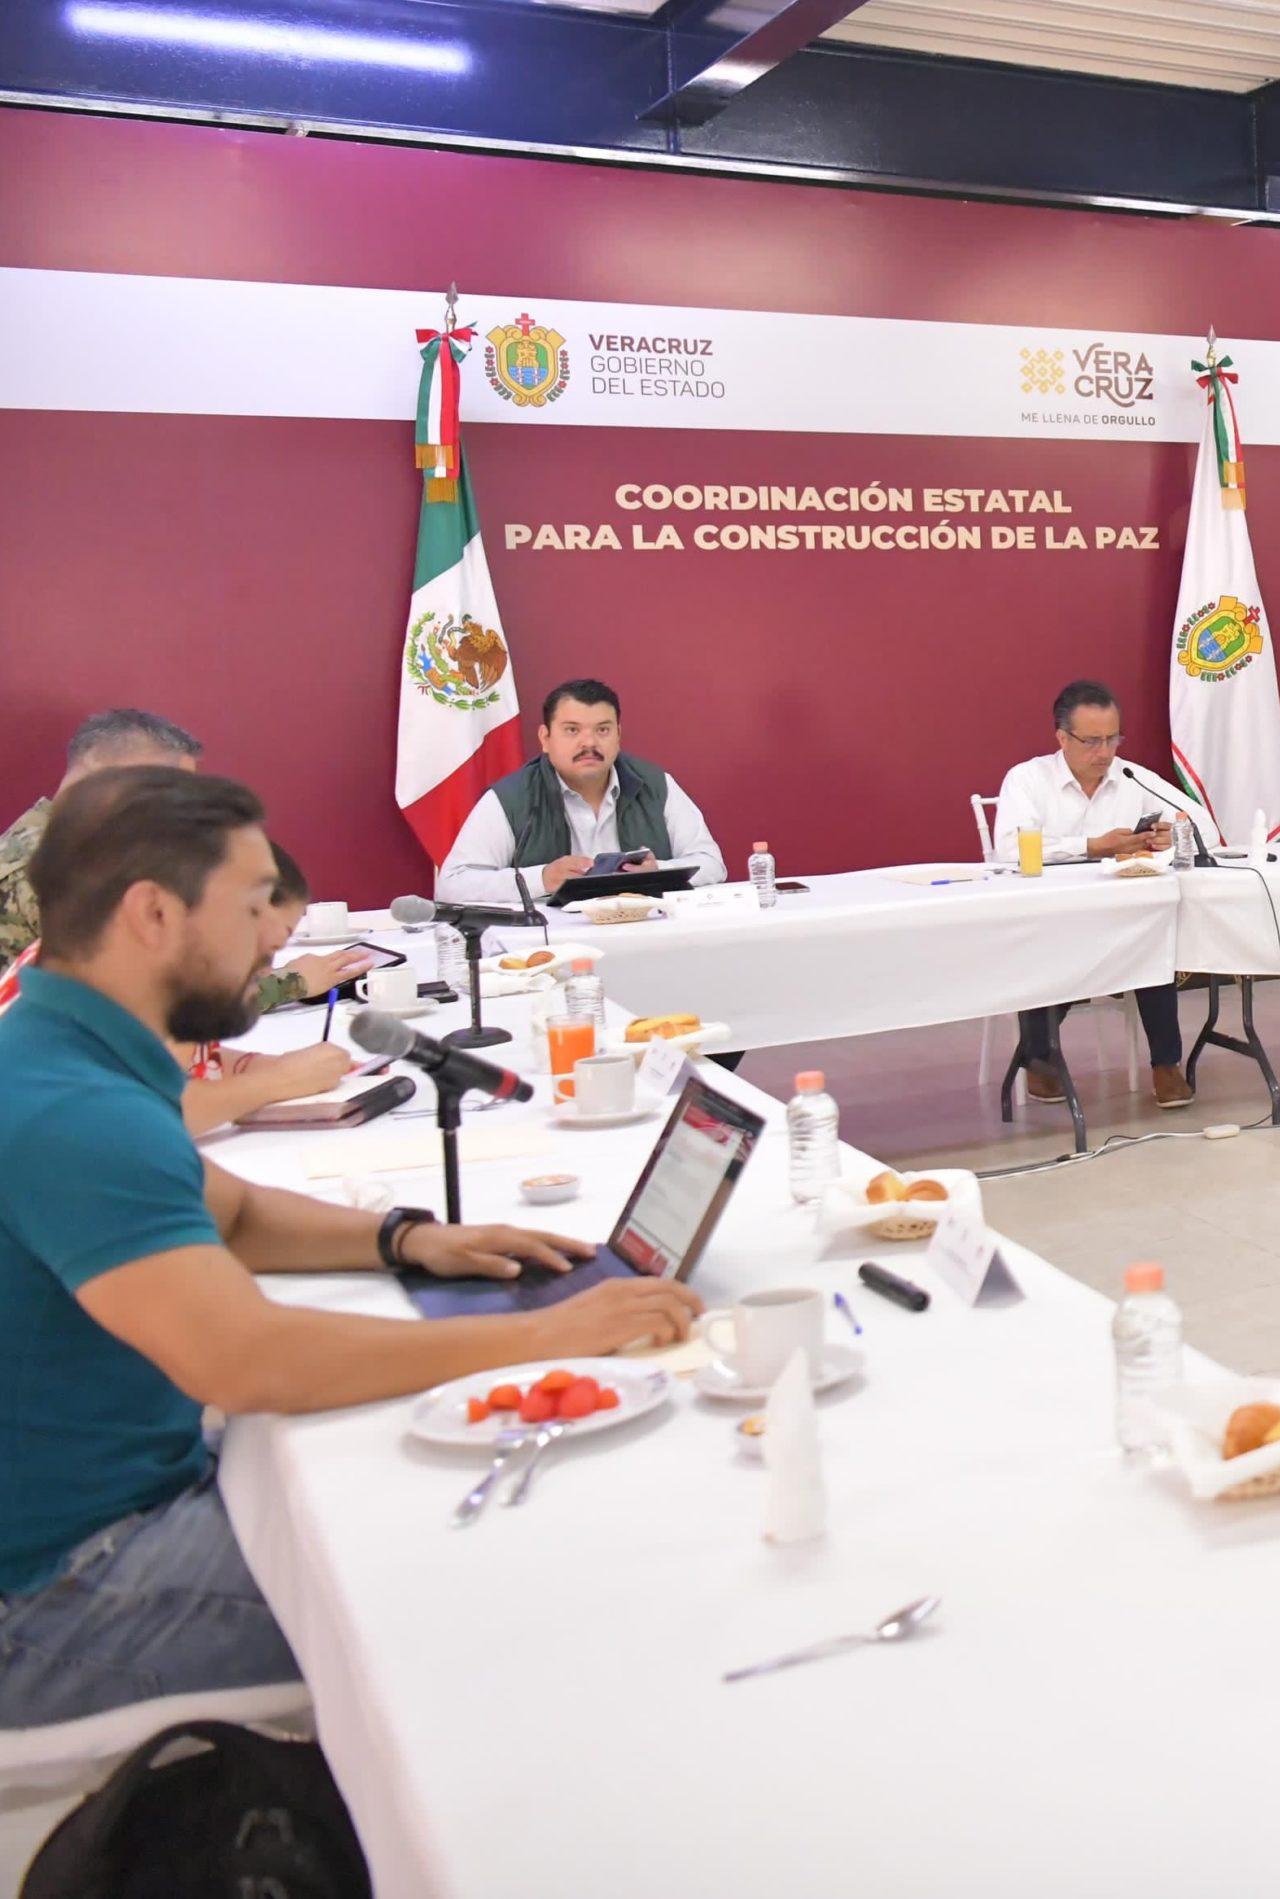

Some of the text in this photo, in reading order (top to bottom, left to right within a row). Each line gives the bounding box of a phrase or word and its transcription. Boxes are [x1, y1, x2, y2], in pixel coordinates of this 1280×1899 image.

[588, 333, 714, 356] VERACRUZ
[590, 355, 705, 377] GOBIERNO
[1072, 342, 1154, 376] VERA
[592, 376, 725, 399] DEL ESTADO
[1074, 375, 1154, 408] CRUZ
[1021, 412, 1156, 426] ME LLENA DE ORGULLO
[614, 480, 1073, 514] COORDINACIÓN ESTATAL
[504, 519, 1160, 551] PARA LA CONSTRUCCIÓN DE LA PAZ
